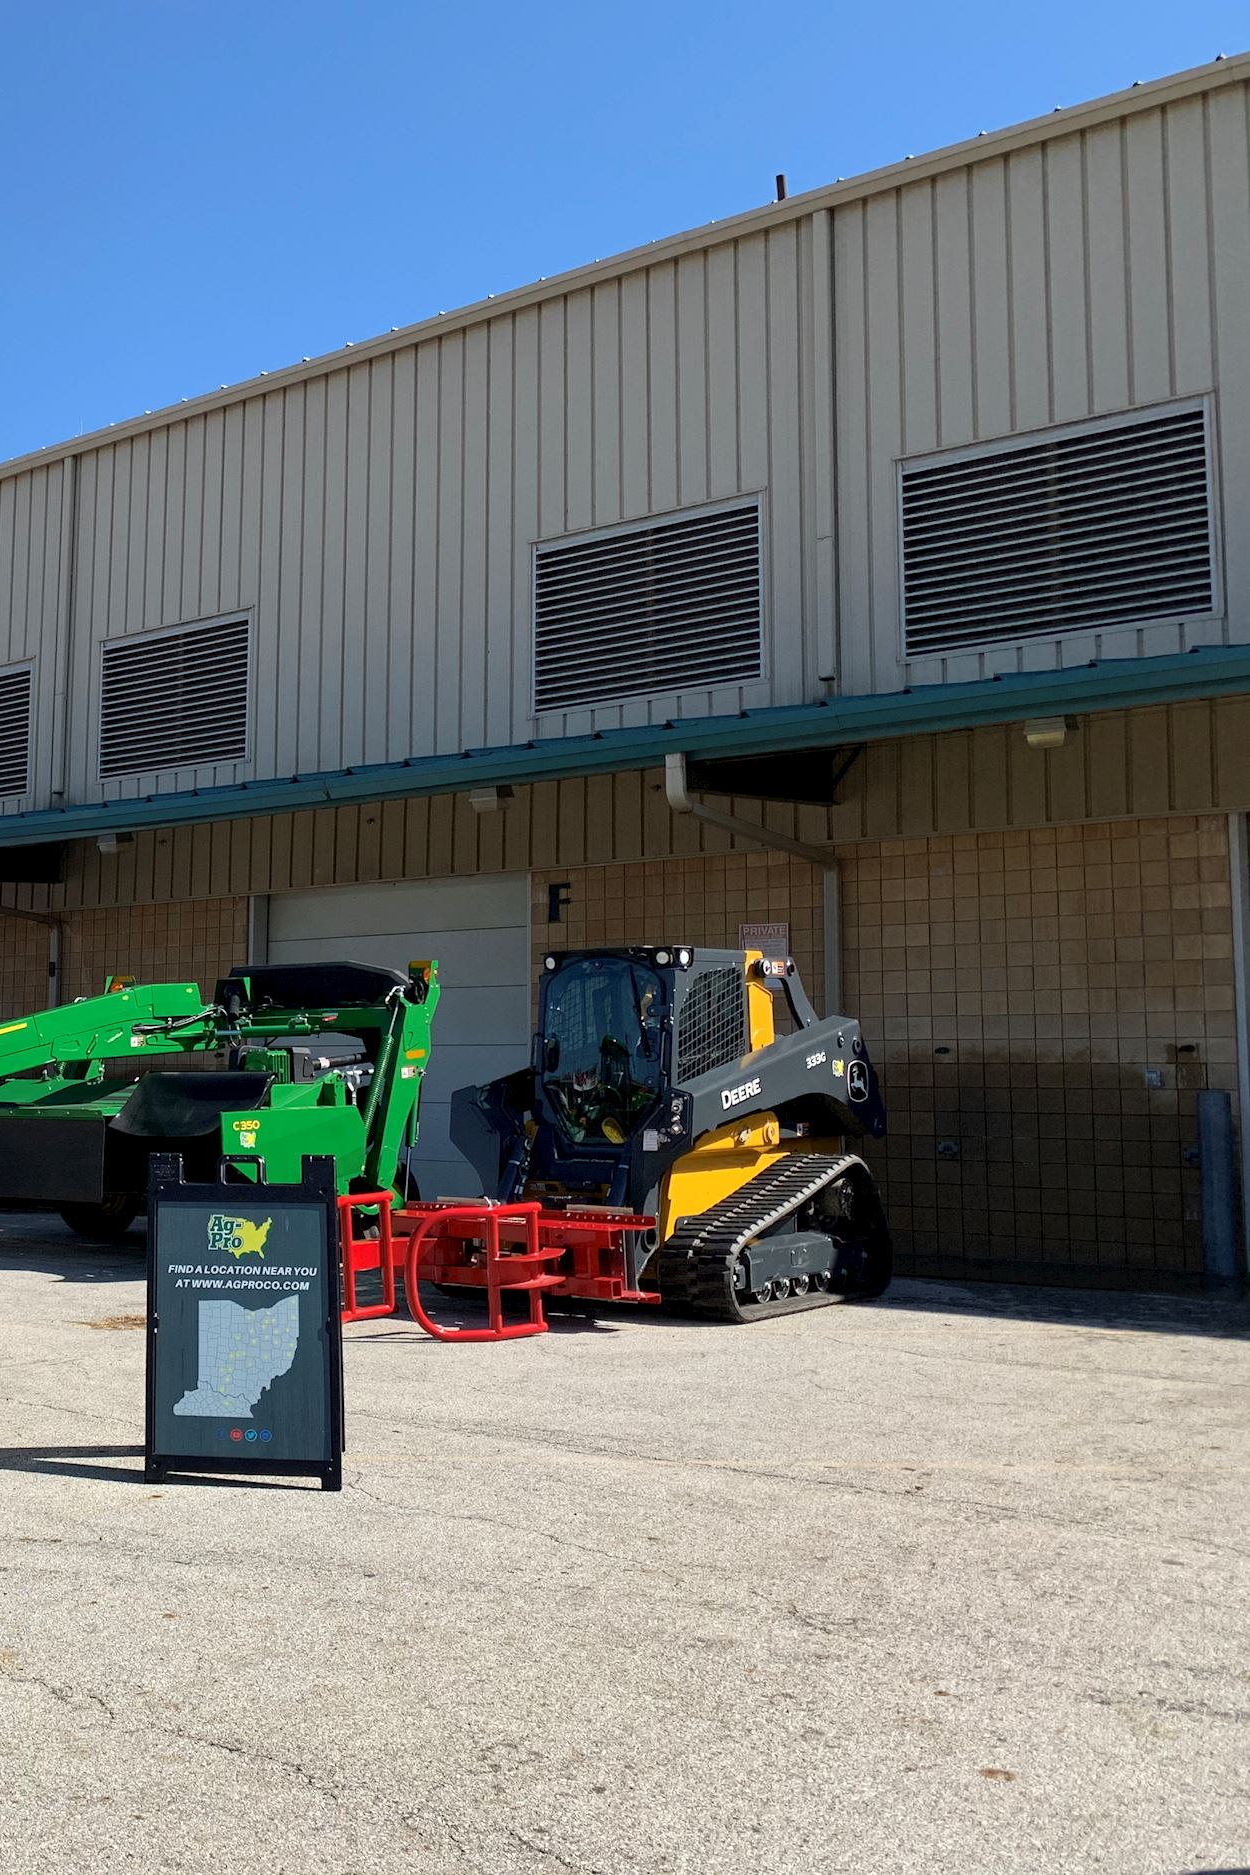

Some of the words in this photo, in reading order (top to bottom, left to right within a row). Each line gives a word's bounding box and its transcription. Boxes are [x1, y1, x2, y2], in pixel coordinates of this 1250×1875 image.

[549, 883, 571, 923] F
[743, 926, 786, 936] PRIVATE
[805, 1051, 827, 1070] 333G
[721, 1078, 762, 1110] DEERE
[209, 1214, 243, 1236] Ag-
[208, 1232, 243, 1250] Pro
[168, 1264, 194, 1274] FIND
[195, 1265, 203, 1274] A
[204, 1265, 261, 1275] LOCATION
[262, 1266, 293, 1276] NEAR
[294, 1267, 317, 1277] YOU
[175, 1279, 191, 1288] AT
[191, 1279, 310, 1291] WWW.AGPROCO.COM
